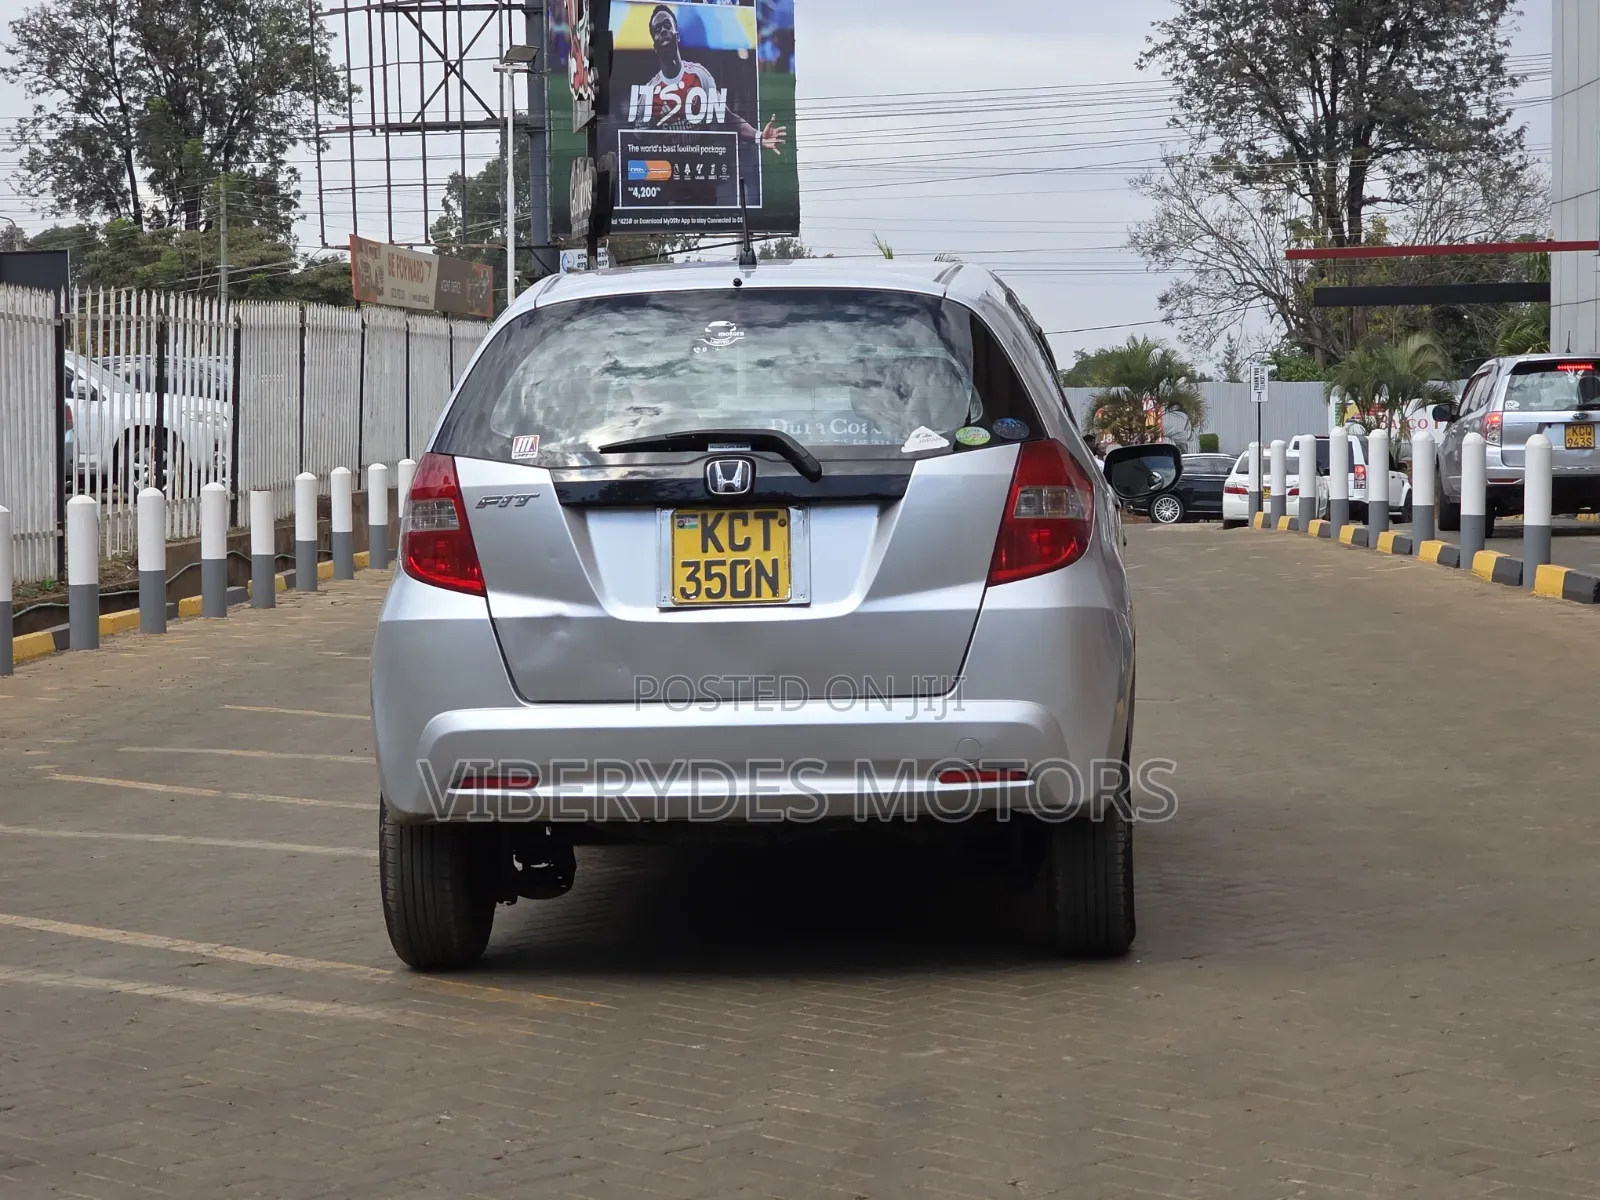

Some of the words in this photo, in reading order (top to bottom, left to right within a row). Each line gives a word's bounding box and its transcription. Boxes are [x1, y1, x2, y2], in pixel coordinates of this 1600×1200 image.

[628, 81, 685, 126] IT'S
[685, 86, 727, 124] ON
[627, 144, 639, 152] The
[640, 144, 662, 153] world's
[663, 145, 676, 153] best
[677, 144, 699, 153] football
[701, 146, 726, 155] package
[681, 217, 690, 225] App
[387, 252, 396, 278] BE
[396, 255, 425, 284] FORWARD
[1572, 426, 1592, 437] KCQ
[1567, 438, 1593, 447] 943S
[475, 492, 541, 509] FIT
[700, 511, 779, 553] KCT
[679, 557, 780, 600] 350N
